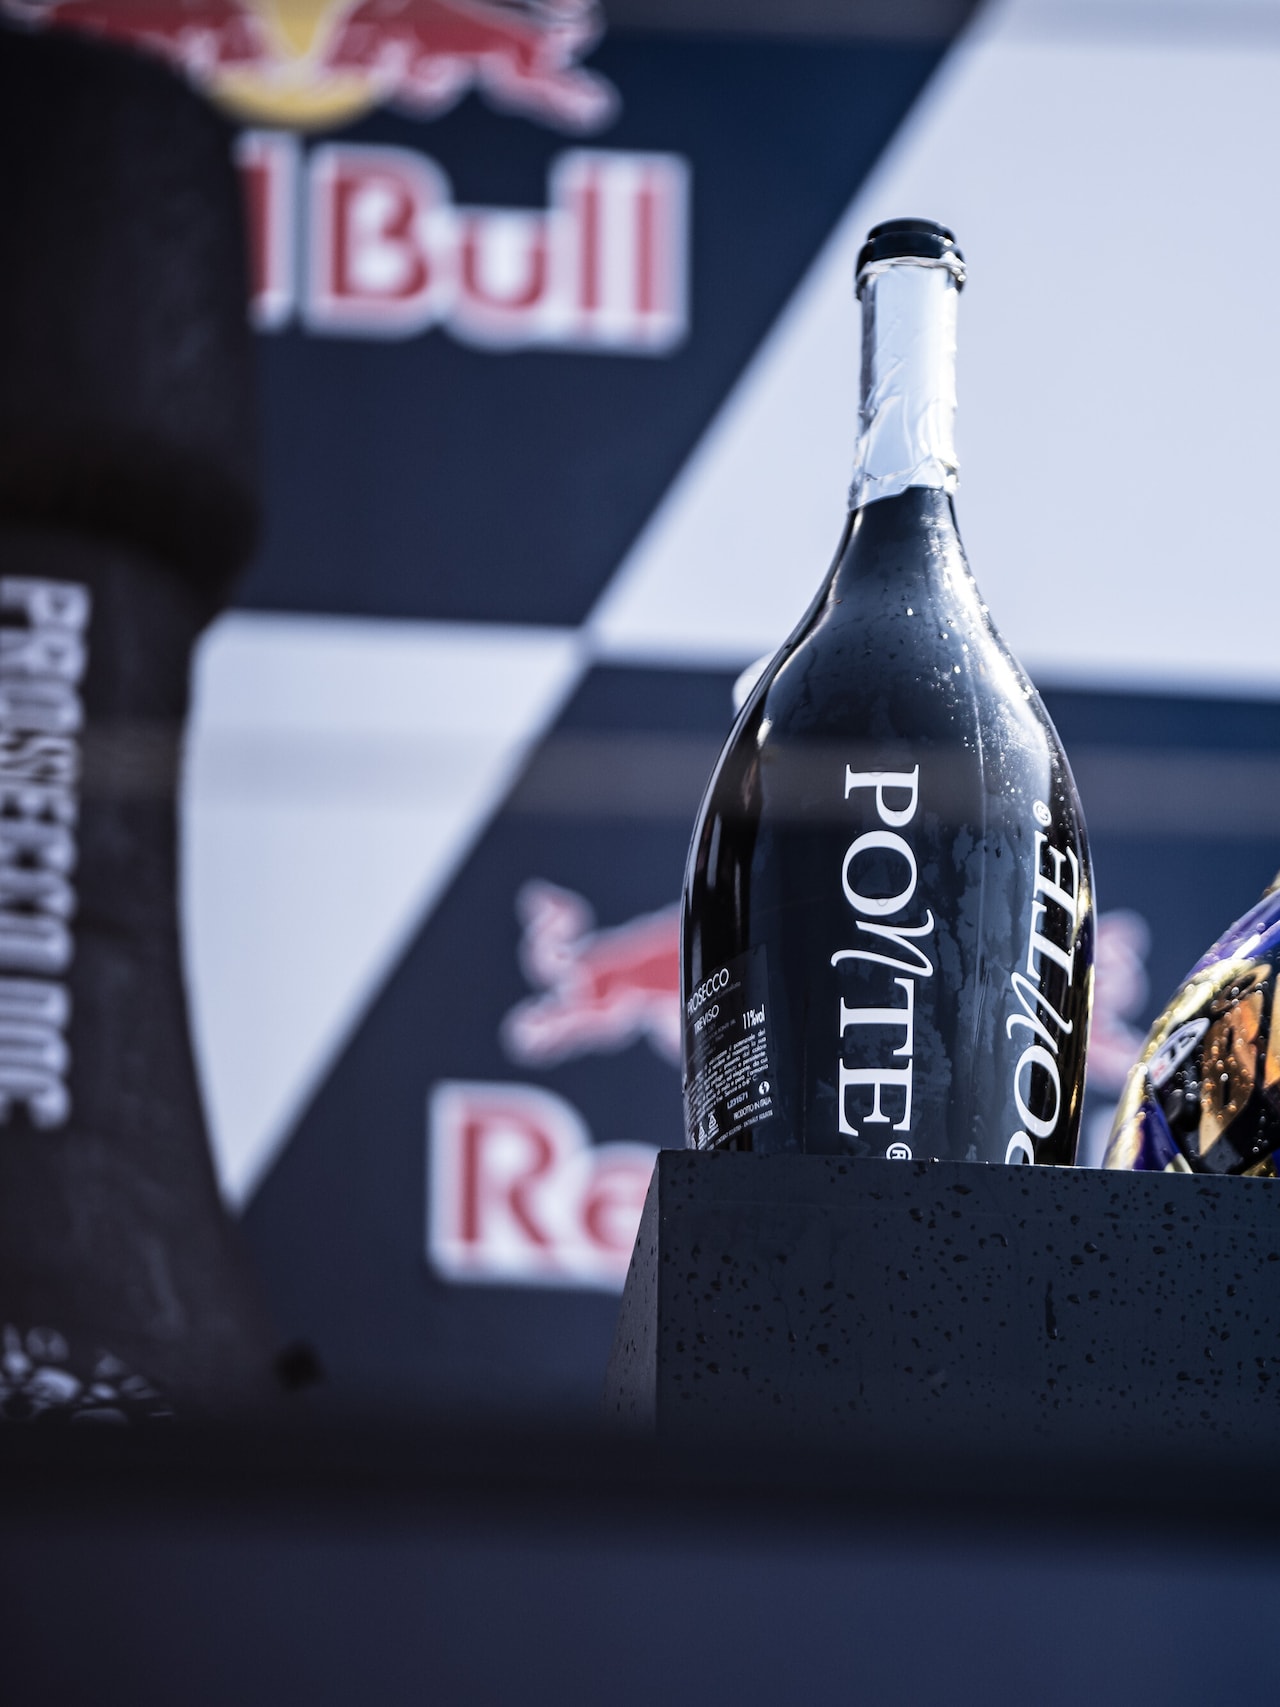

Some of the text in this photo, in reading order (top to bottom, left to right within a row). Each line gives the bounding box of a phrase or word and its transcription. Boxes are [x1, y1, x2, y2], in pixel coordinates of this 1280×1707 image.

[304, 143, 690, 356] Bull
[687, 967, 729, 1020] PROSECCO
[694, 1004, 719, 1035] TREVISO
[428, 1078, 657, 1297] Re
